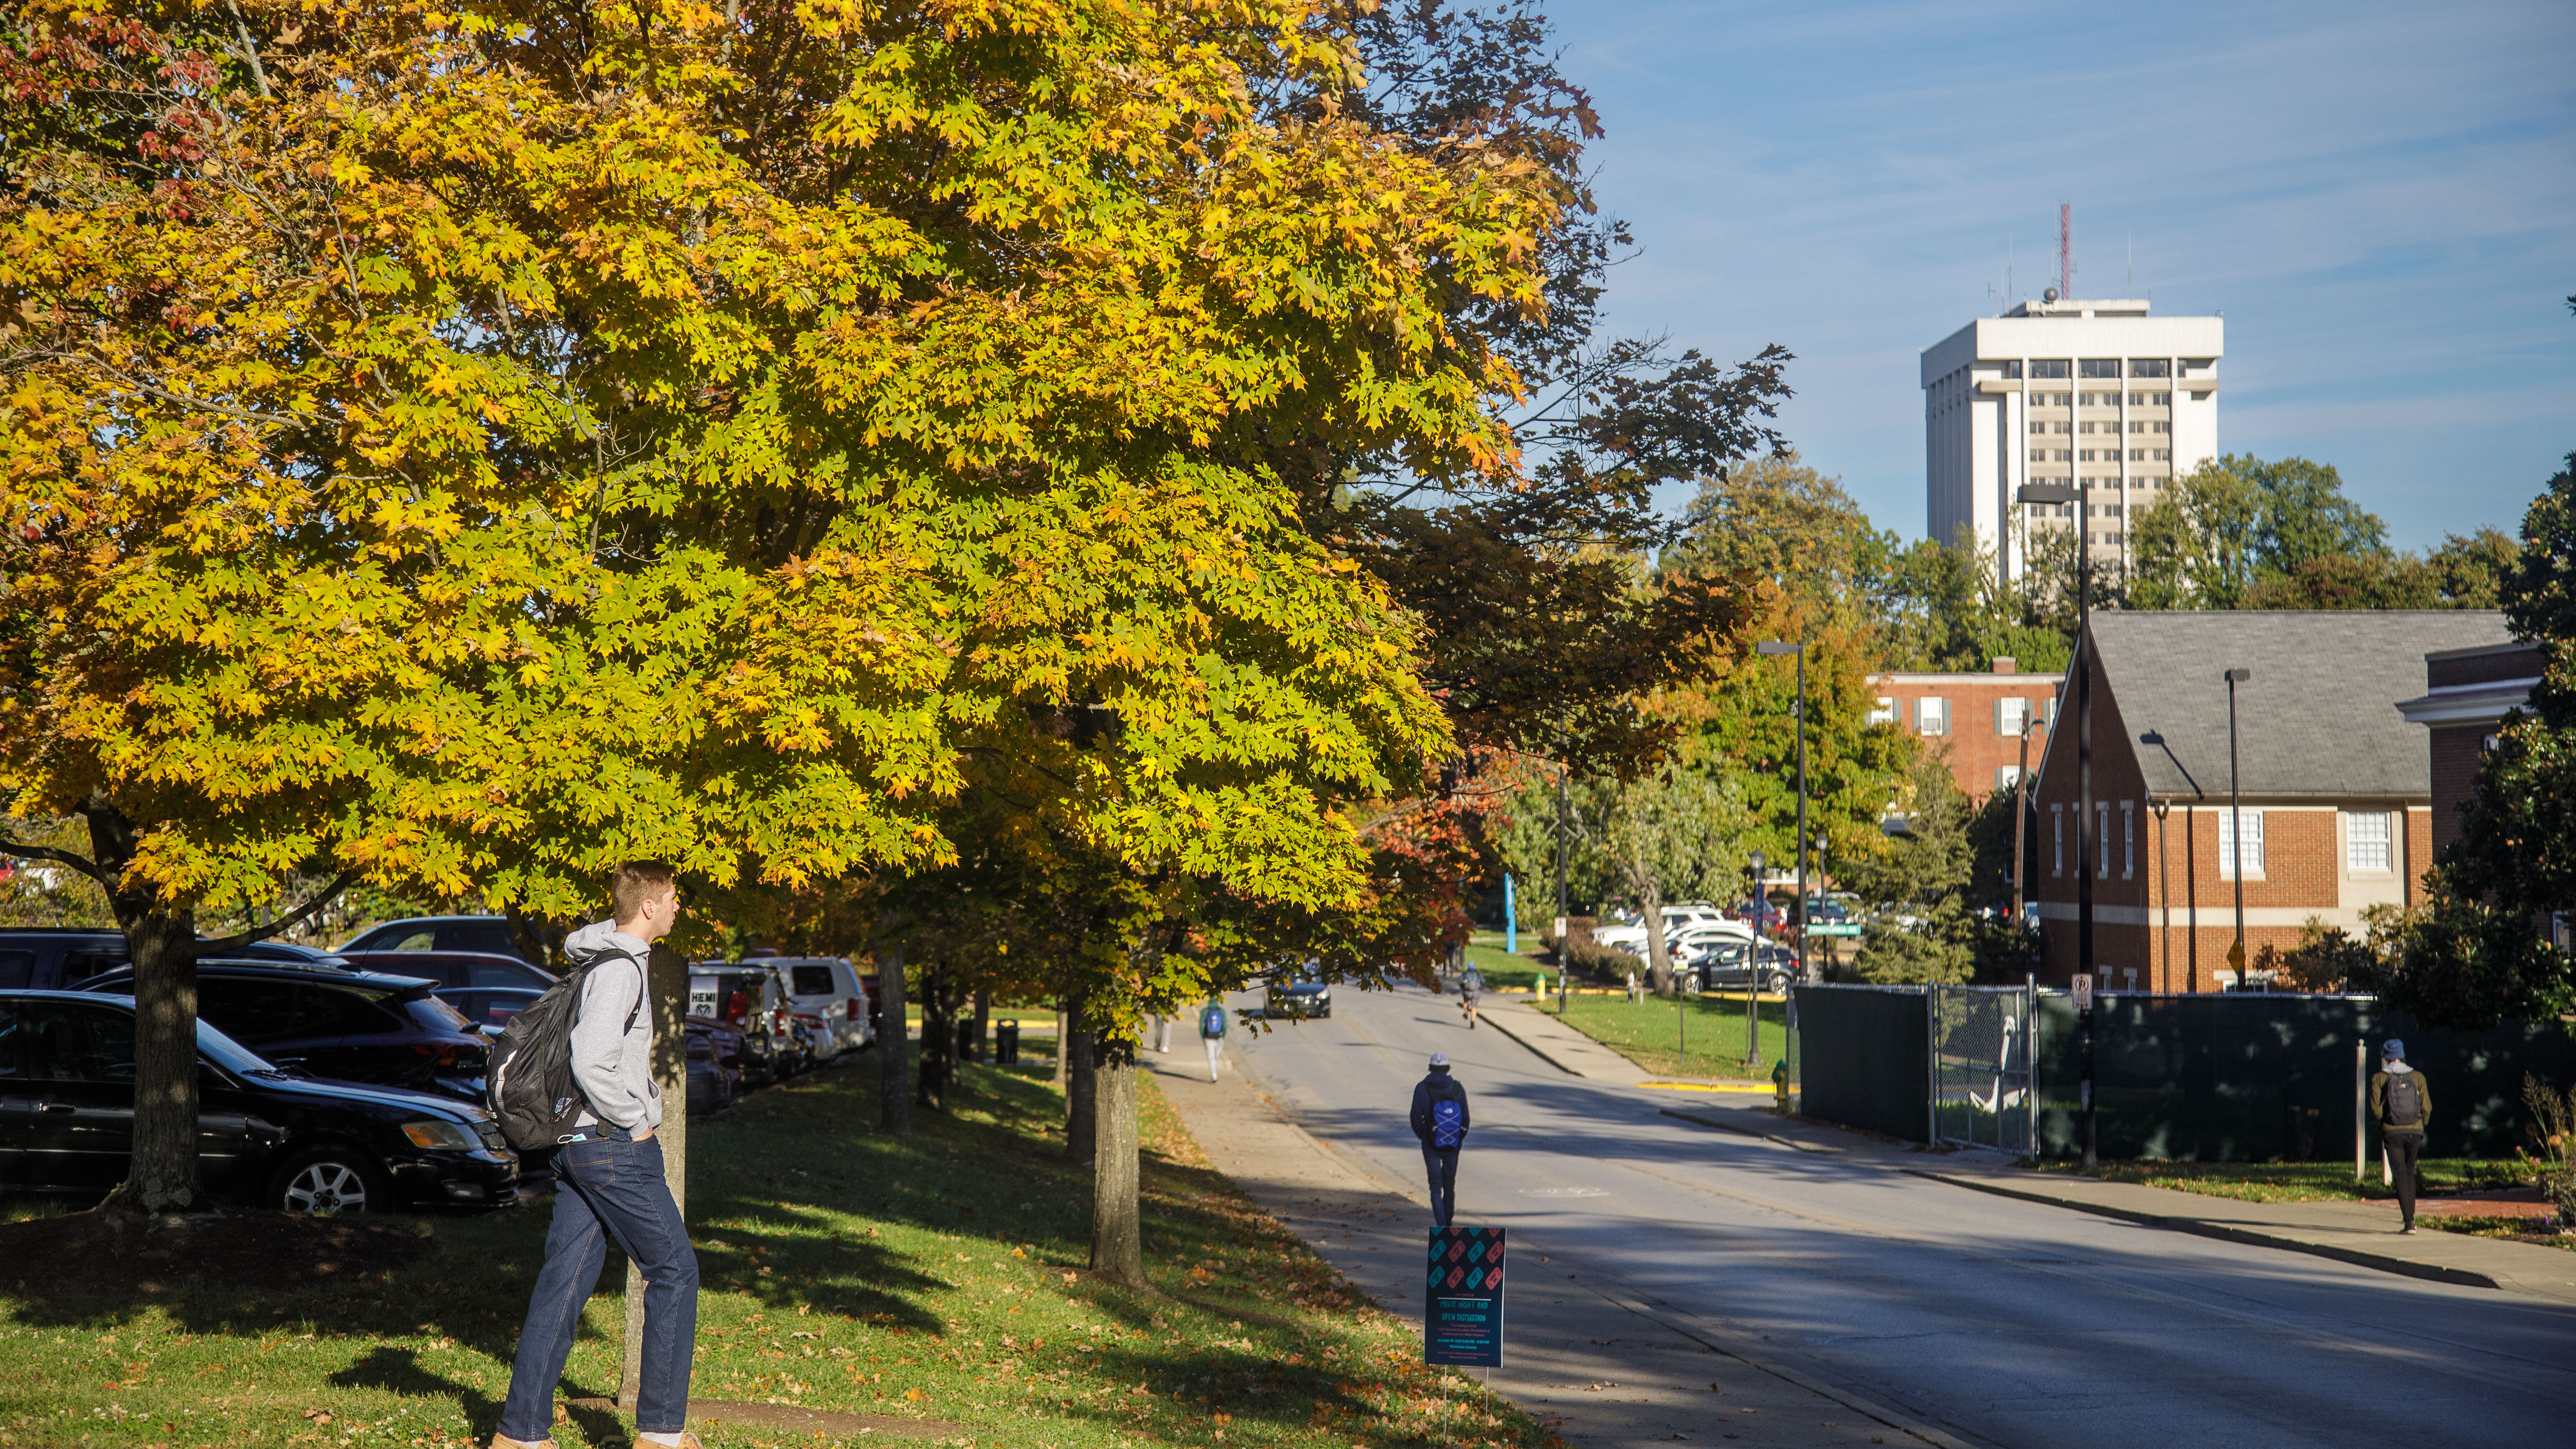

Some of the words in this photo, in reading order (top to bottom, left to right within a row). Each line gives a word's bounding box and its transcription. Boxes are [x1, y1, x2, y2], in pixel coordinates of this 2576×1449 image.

[1809, 925, 1847, 934] PENNSYLVANIA
[1848, 925, 1858, 934] AVE
[692, 992, 716, 1002] HEMI
[1456, 1314, 1486, 1322] DISCUSSION
